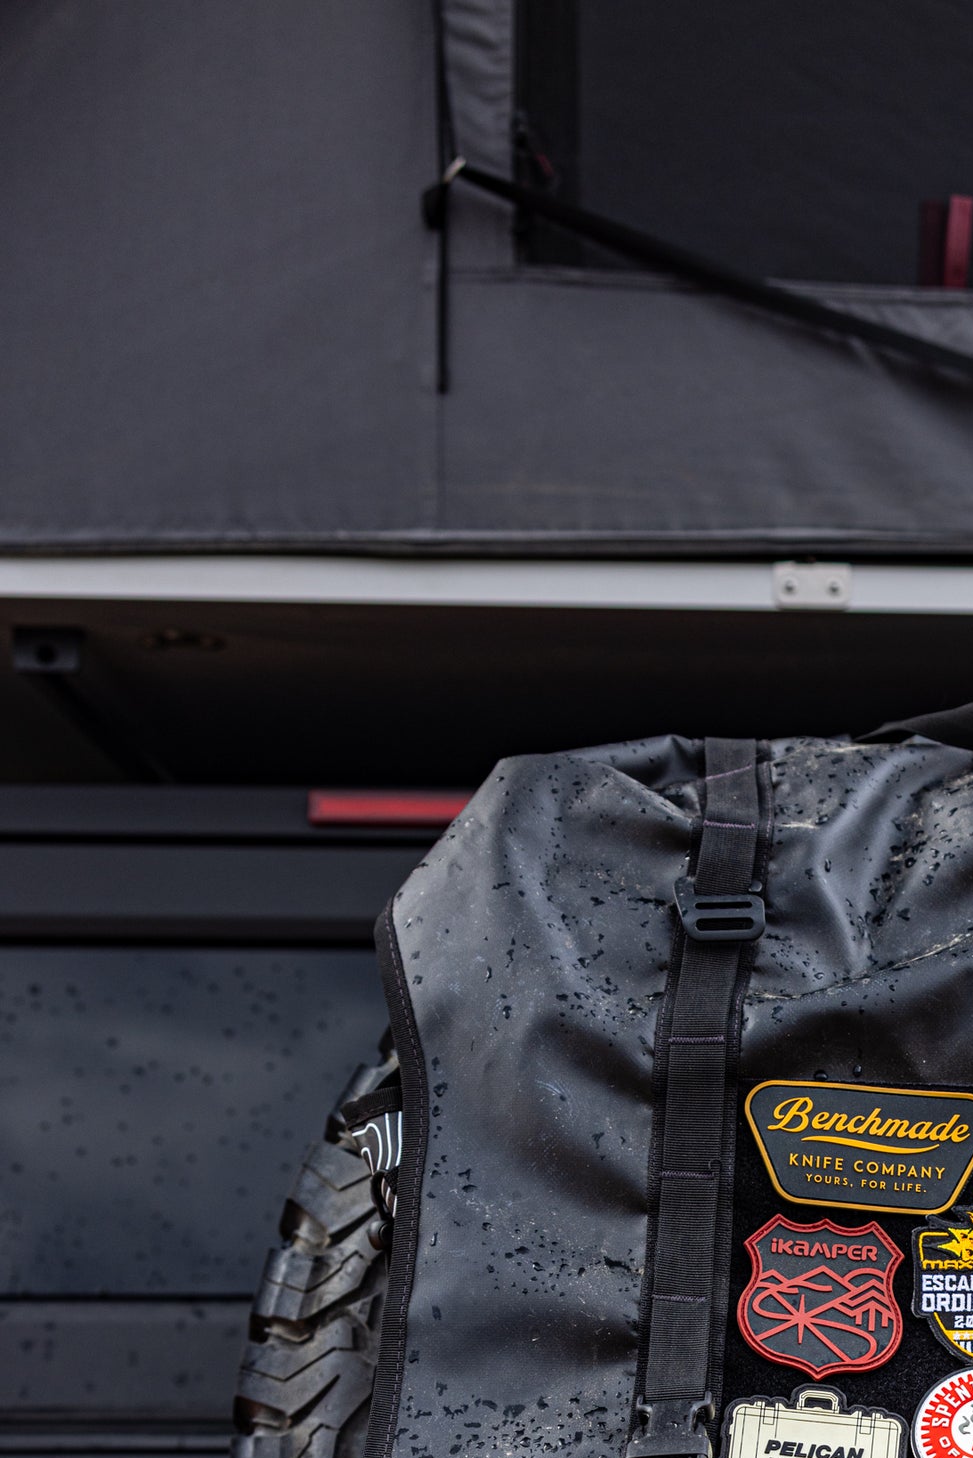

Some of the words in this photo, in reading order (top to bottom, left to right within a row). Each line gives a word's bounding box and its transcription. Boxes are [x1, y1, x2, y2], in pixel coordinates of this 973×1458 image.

[767, 1096, 971, 1143] Benchmade
[789, 1153, 844, 1171] KNIFE
[853, 1160, 946, 1179] COMPANY
[805, 1174, 853, 1188] YOURS,
[861, 1179, 886, 1190] FOR
[893, 1182, 927, 1193] LIFE.
